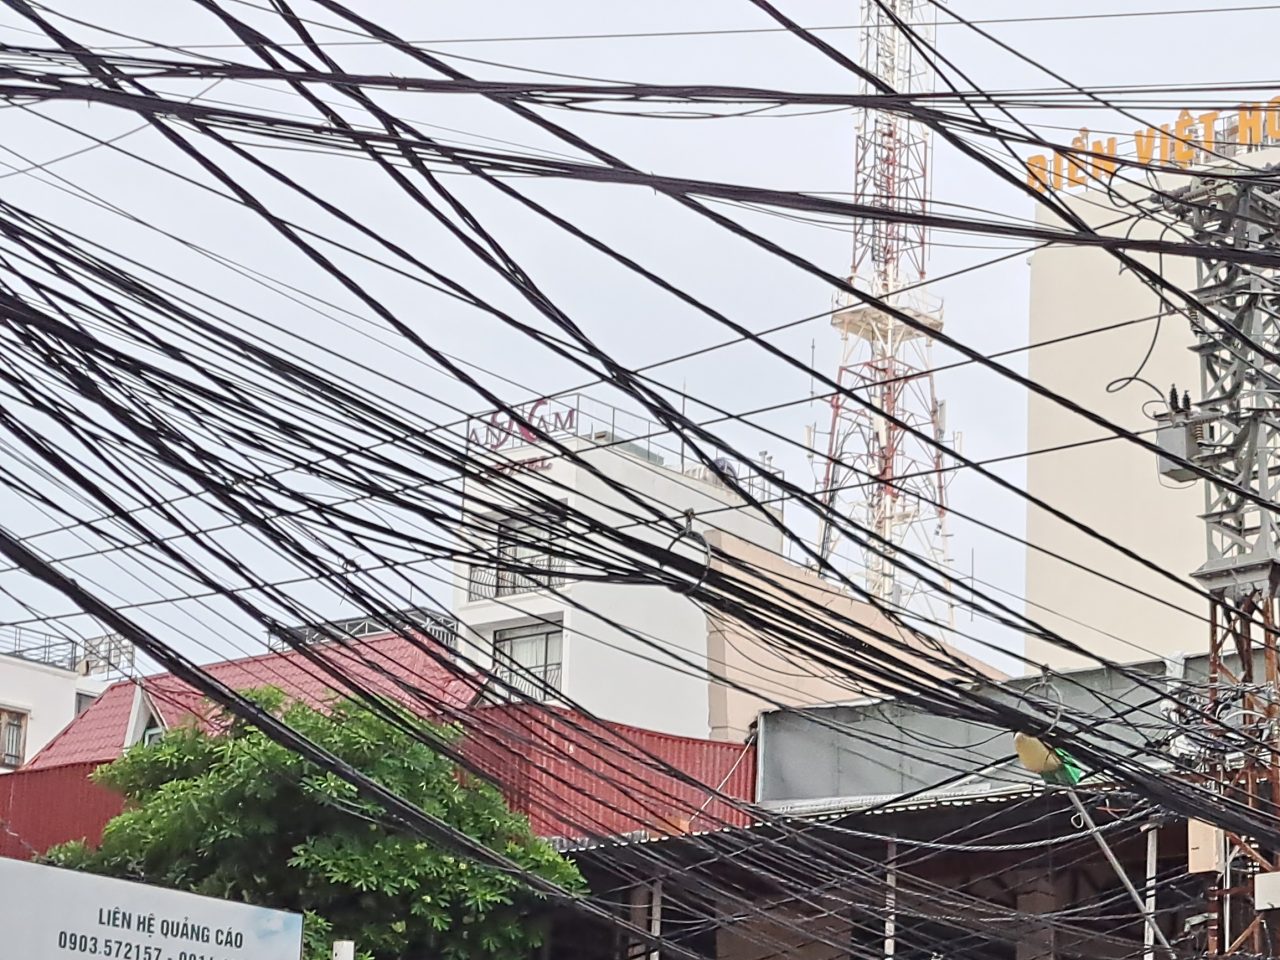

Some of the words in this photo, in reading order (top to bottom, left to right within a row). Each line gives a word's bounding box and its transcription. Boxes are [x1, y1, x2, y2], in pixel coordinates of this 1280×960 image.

[98, 906, 133, 930] LIÊN
[136, 913, 155, 938] HỆ
[160, 916, 210, 944] QUẢNG
[215, 927, 244, 949] CÁO
